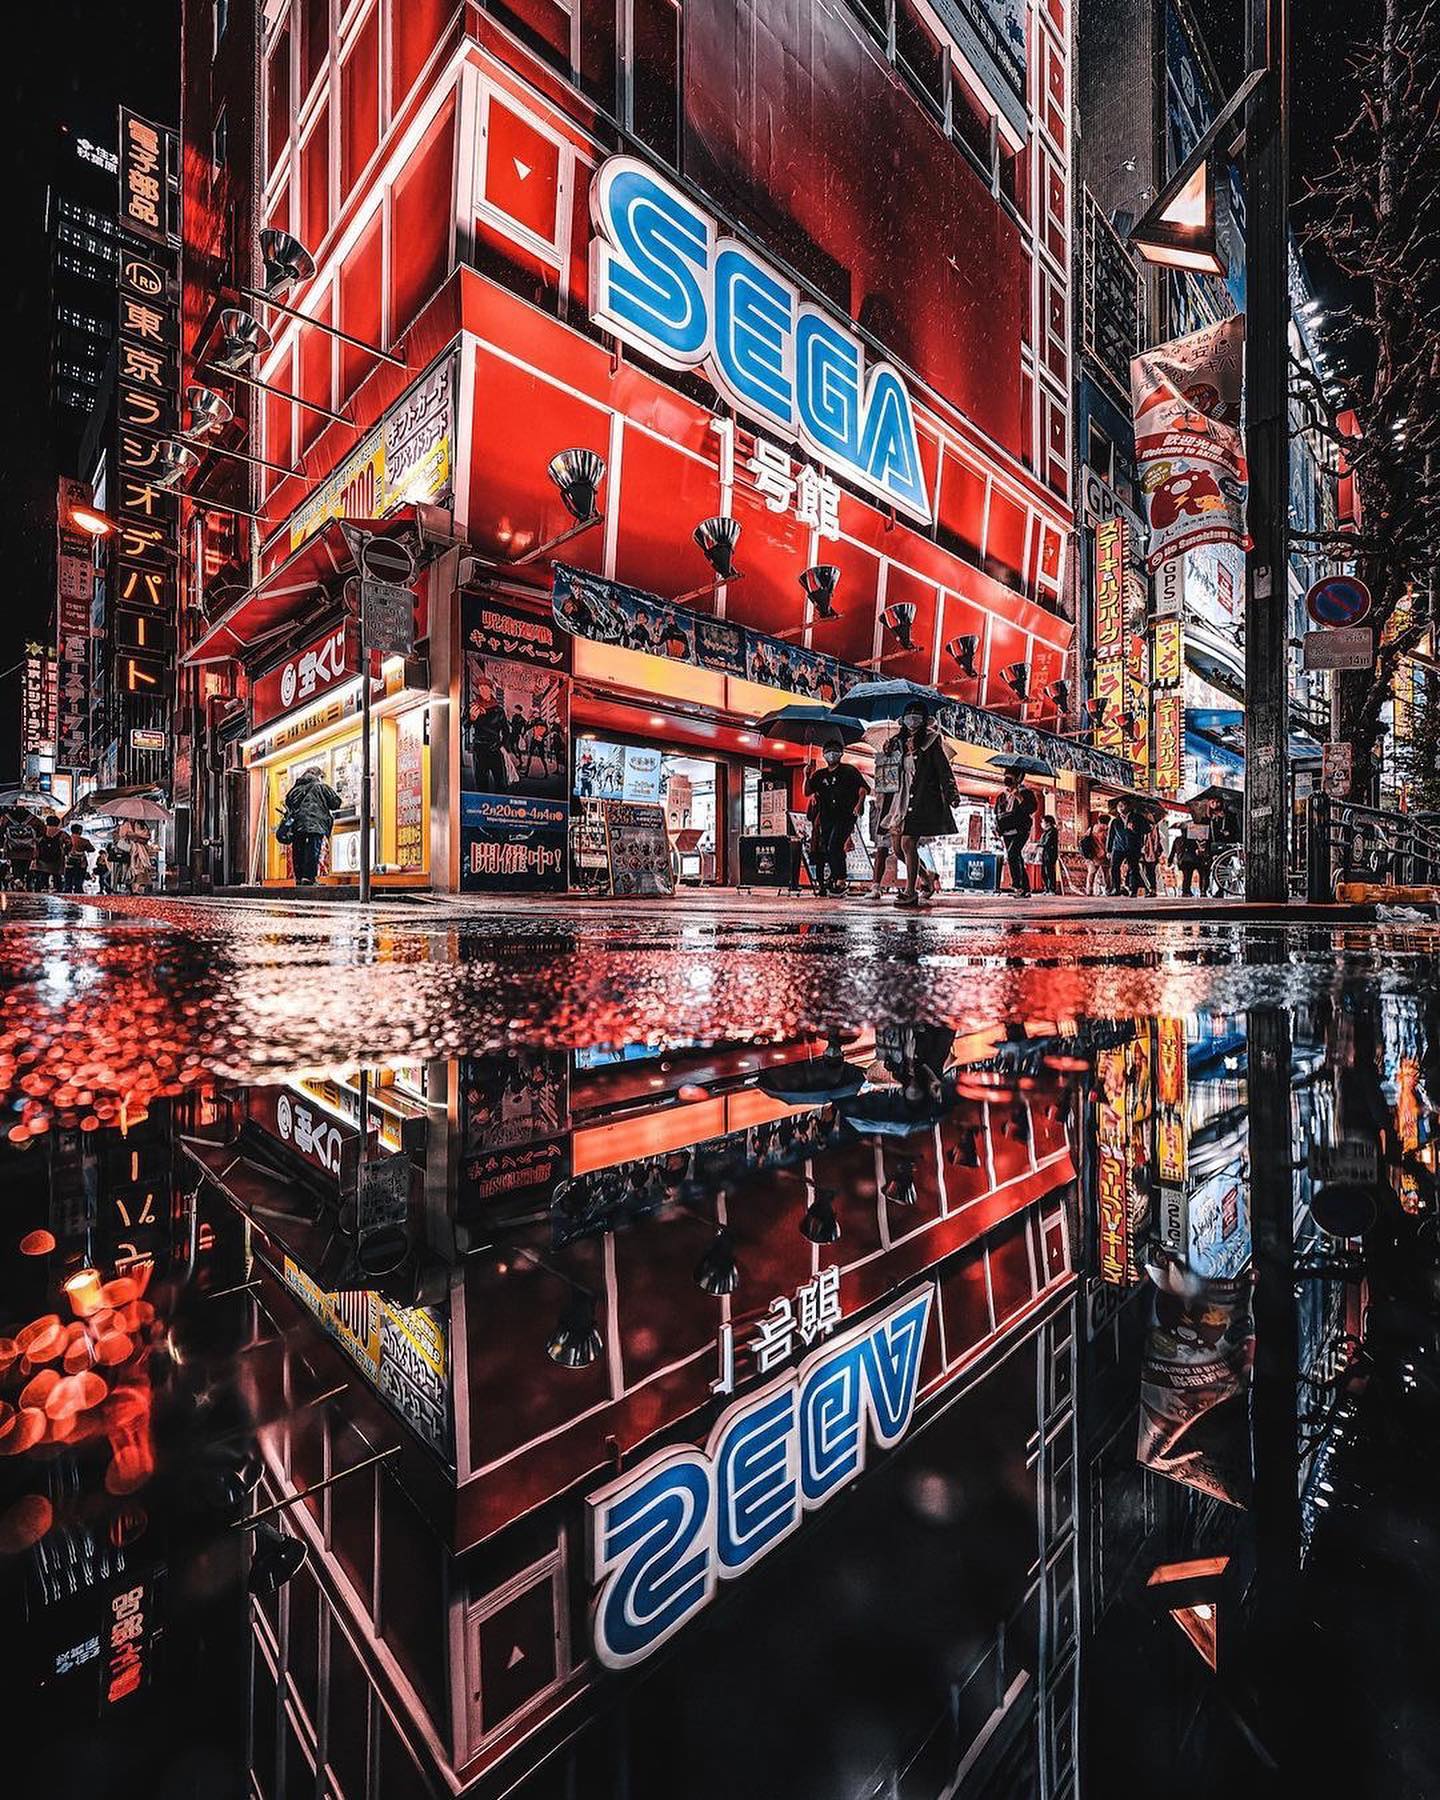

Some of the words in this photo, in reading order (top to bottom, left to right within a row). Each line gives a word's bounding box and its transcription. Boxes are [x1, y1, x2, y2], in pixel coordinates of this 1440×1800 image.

[128, 119, 160, 227] 電子部品
[588, 154, 933, 526] SEGA
[388, 370, 448, 448] ギフトカード
[709, 417, 841, 541] 1号館
[1163, 560, 1177, 600] GPS
[298, 631, 346, 699] 宝くじ
[469, 629, 563, 663] キャンペーン
[1096, 644, 1123, 659] 2F
[470, 841, 562, 875] 開催中!
